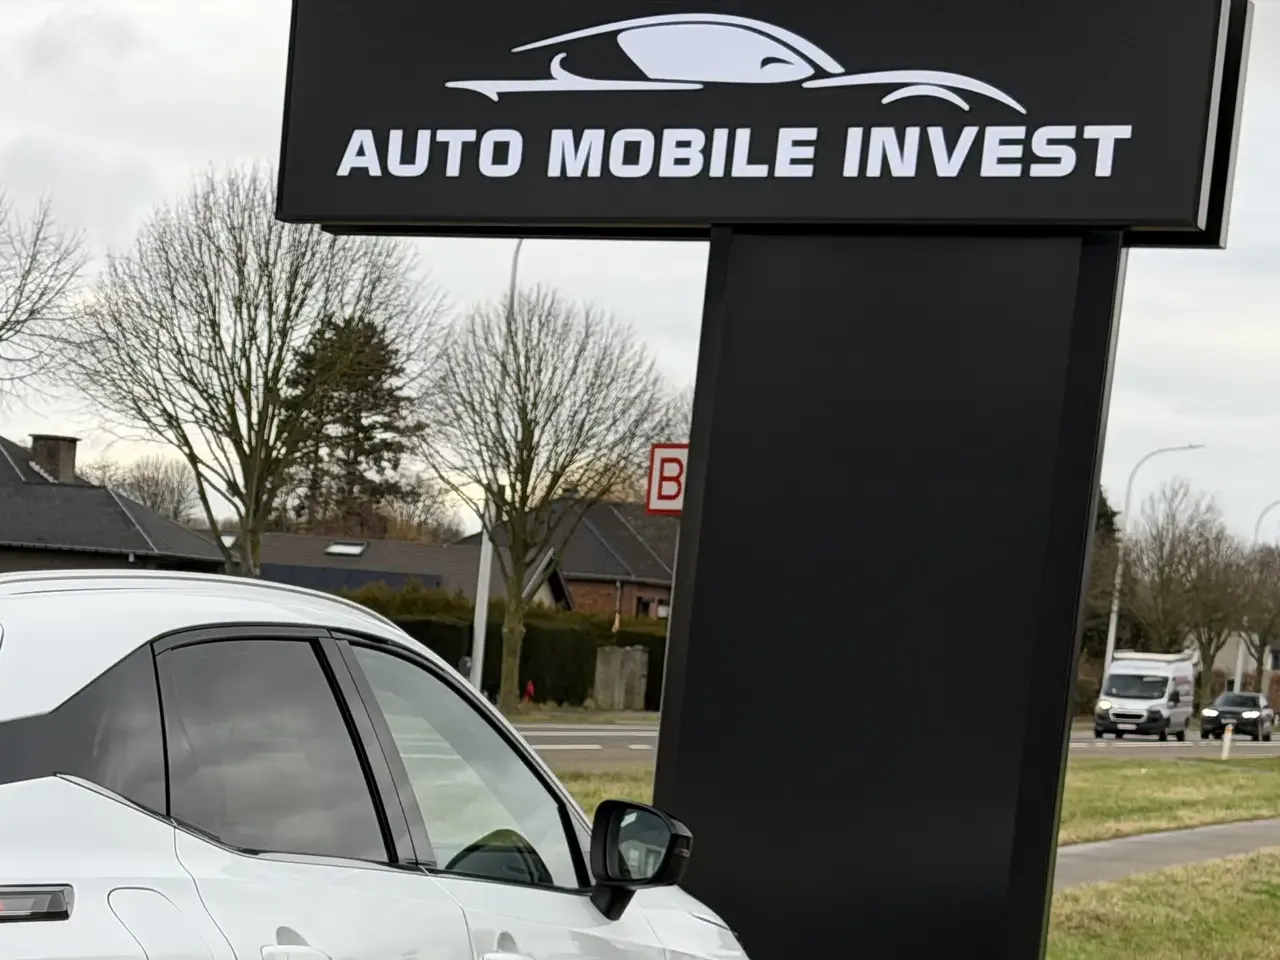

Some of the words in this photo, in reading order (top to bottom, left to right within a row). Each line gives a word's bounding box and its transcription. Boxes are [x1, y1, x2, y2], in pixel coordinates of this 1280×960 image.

[335, 128, 524, 178] AUTO
[546, 127, 819, 178] MOBILE
[841, 124, 1134, 178] INVEST
[658, 457, 684, 500] B
